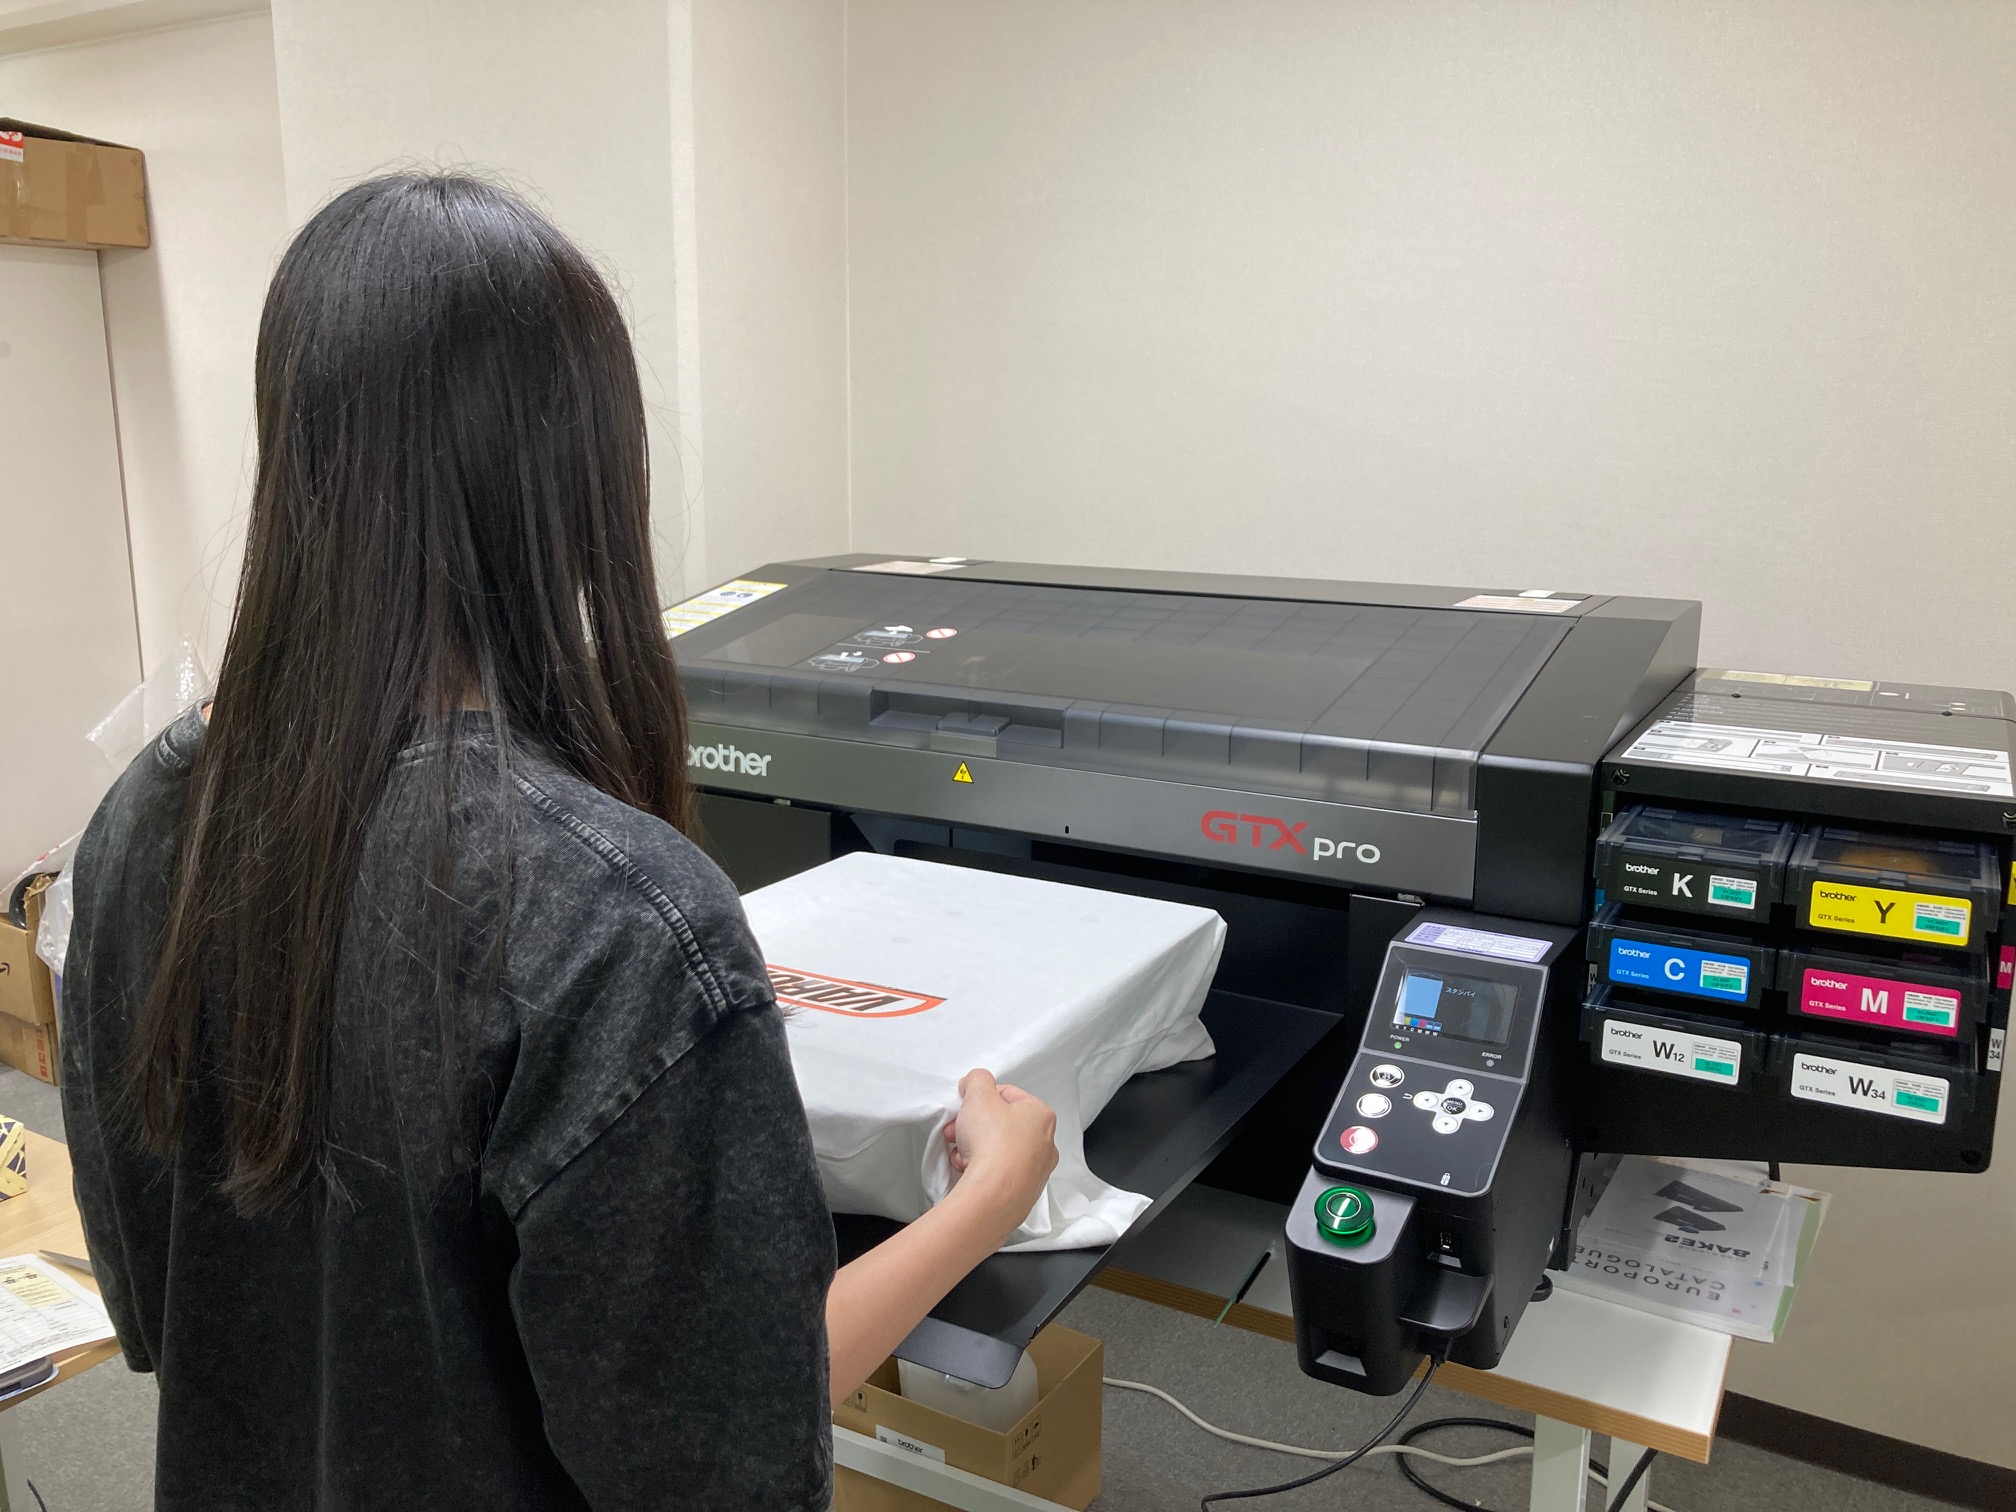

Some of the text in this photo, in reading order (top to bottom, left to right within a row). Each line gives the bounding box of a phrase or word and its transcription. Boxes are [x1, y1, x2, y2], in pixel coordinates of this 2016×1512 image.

[1201, 810, 1381, 864] GTX pro
[1625, 862, 1660, 876] brother
[1623, 885, 1658, 896] GTX Series
[1671, 873, 1694, 898] K
[1819, 889, 1857, 902] brother
[1818, 913, 1855, 924] GTX Series
[1873, 900, 1897, 924] Y
[1618, 946, 1651, 959] brother
[1616, 968, 1650, 979] GTX Series
[1664, 958, 1686, 981] C
[1810, 976, 1848, 990] brother
[1446, 986, 1476, 998] スタンバイ
[1808, 1000, 1846, 1012] GTX Series
[1860, 987, 1889, 1015] M
[1390, 1034, 1410, 1042] POWER
[1610, 1027, 1643, 1040] brother
[1481, 1052, 1502, 1060] ERROR
[1609, 1049, 1642, 1060] GTX Series
[1801, 1061, 1838, 1076] brother
[1799, 1084, 1836, 1096] GTX Series
[1575, 1245, 1726, 1291] CATALOGUE
